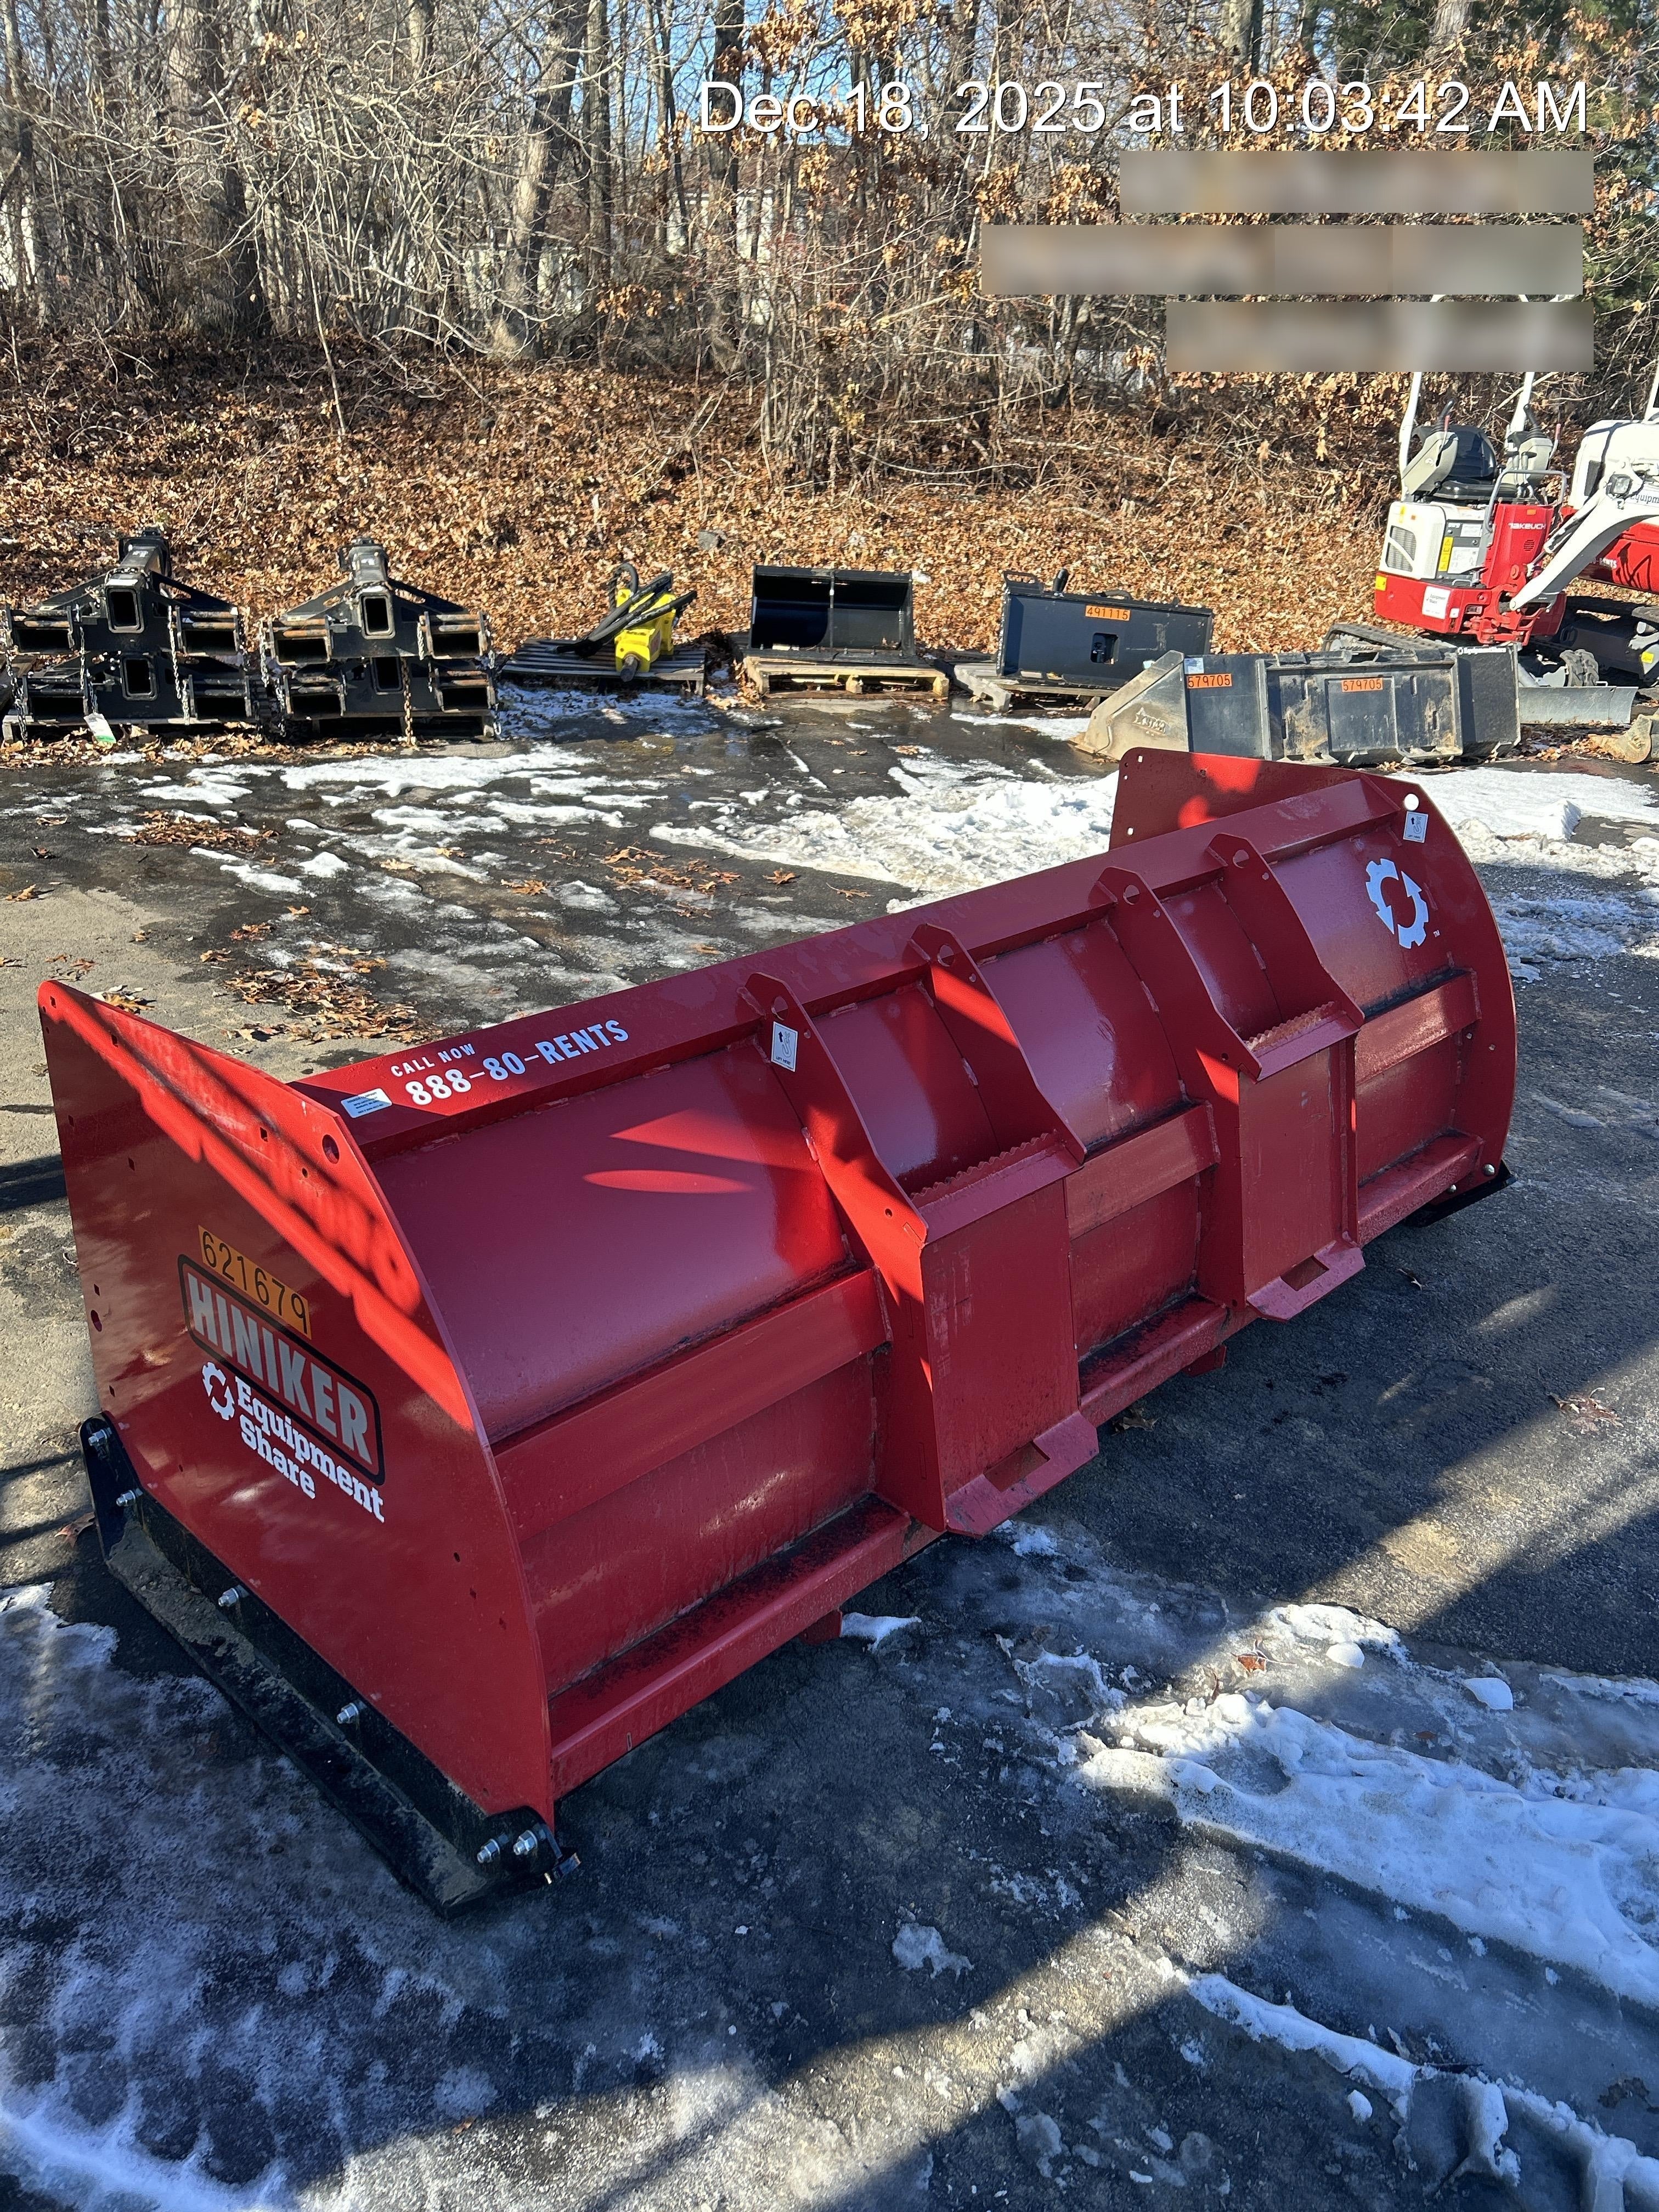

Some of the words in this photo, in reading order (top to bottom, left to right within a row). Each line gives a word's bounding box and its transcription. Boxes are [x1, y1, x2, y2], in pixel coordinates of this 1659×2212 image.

[1630, 494, 1659, 504] quipm
[1087, 607, 1128, 620] 491115
[1188, 674, 1231, 688] 579705
[1343, 679, 1381, 691] 579705
[391, 1057, 435, 1077] CALL
[437, 1043, 476, 1063] NOW
[405, 1019, 629, 1105] 888-80-RENTS
[202, 1231, 308, 1335] 621679
[188, 1272, 373, 1465] HINIKER
[235, 1376, 385, 1523] Equipment
[240, 1414, 315, 1499] Share
